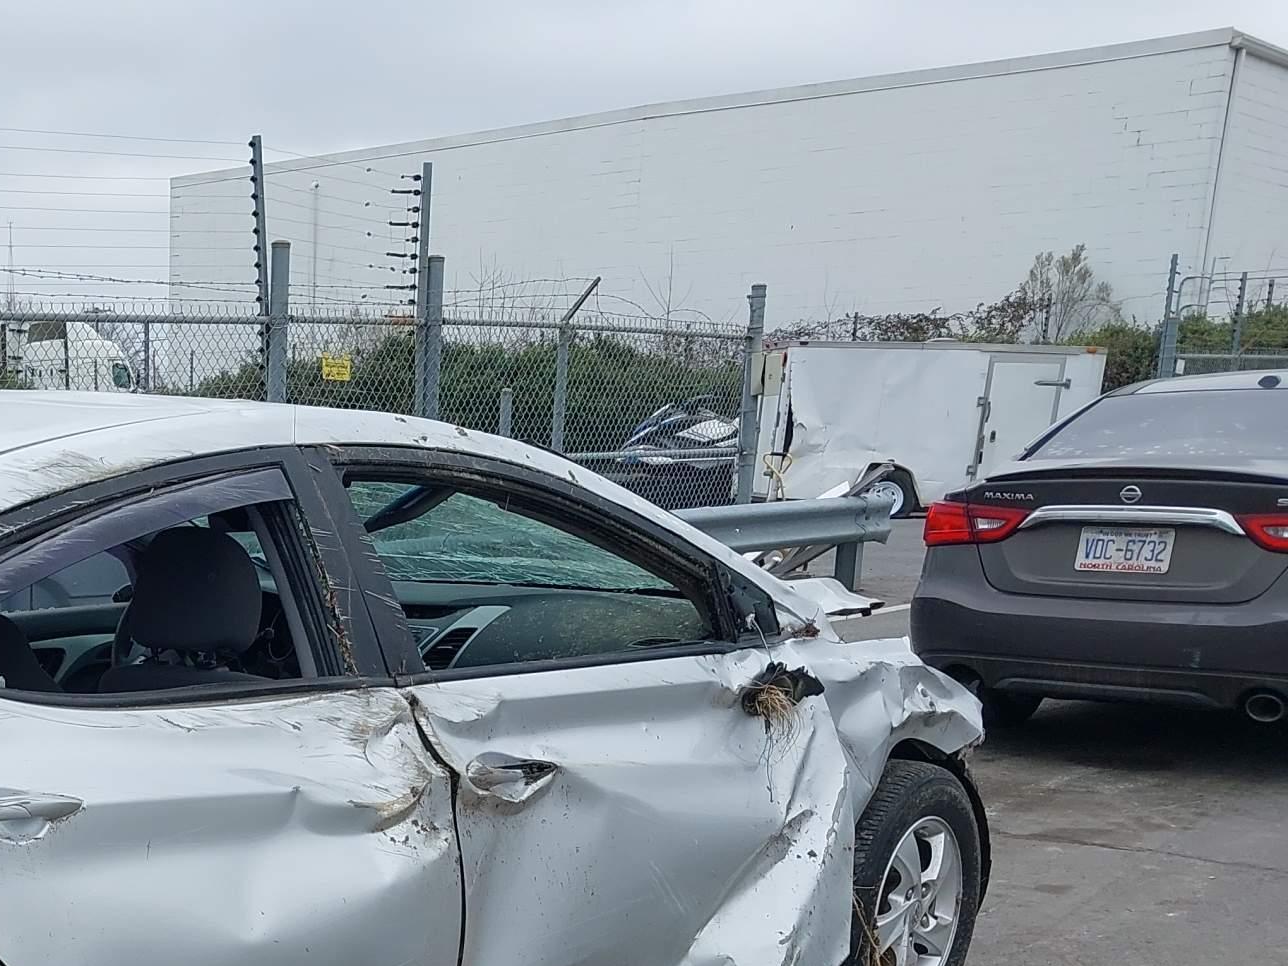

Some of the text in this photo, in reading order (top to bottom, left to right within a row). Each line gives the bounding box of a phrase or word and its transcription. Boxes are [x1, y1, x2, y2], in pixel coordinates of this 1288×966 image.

[984, 491, 1034, 500] MAXIMA
[1085, 538, 1167, 562] VDC-6732
[1079, 562, 1162, 572] NORTH CAROLINA
